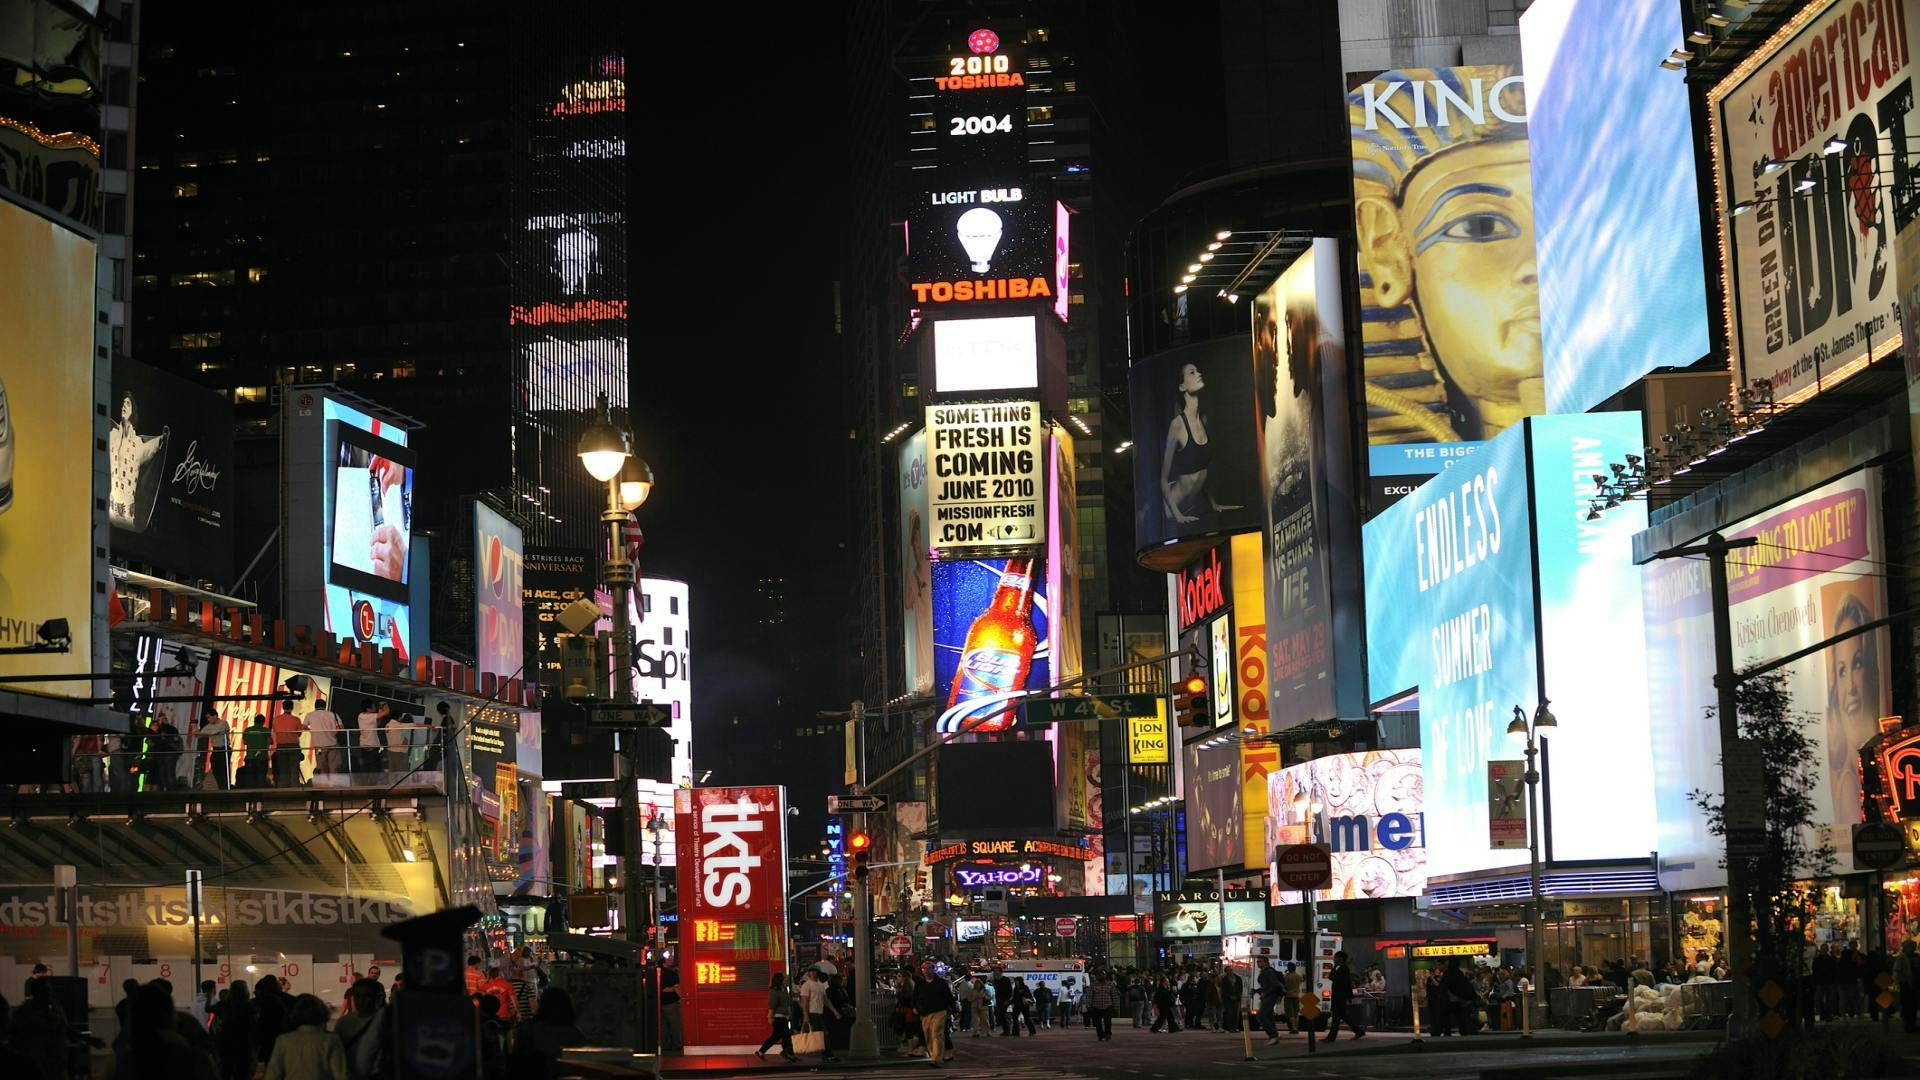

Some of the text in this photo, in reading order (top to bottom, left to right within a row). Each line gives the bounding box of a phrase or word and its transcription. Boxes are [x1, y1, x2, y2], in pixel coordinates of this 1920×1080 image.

[951, 55, 1008, 75] 2010
[936, 73, 1024, 90] TOSHIBA
[951, 115, 1012, 135] 2004
[932, 188, 1023, 205] LIGHT BULB
[912, 278, 1051, 303] TOSHIBA
[1760, 249, 1784, 355] GREEN
[1831, 331, 1855, 356] James
[934, 406, 1031, 425] SOMETHING
[935, 426, 1031, 449] FRESH IS
[1404, 448, 1435, 459] THE
[936, 450, 1033, 477] COMING
[938, 478, 1034, 500] JUNE 2010
[938, 504, 1035, 520] MISSIONFRESH
[939, 523, 983, 542] .COM
[1415, 465, 1501, 592] ENDLESS
[1783, 518, 1798, 558] TO
[1802, 507, 1833, 551] LOVE
[532, 554, 561, 562] STRIKES
[1178, 547, 1224, 631] Kodak
[1432, 603, 1492, 689] SUMMER
[1051, 702, 1065, 716] W
[1111, 698, 1132, 713] St
[1239, 624, 1277, 784] Kodak
[599, 711, 659, 721] ONE WAY
[1133, 722, 1163, 738] LION
[1134, 739, 1164, 755] KING
[838, 800, 880, 808] ONE WAY
[702, 795, 763, 907] tkts
[972, 841, 1018, 853] SQUARE.
[1286, 853, 1321, 862] DO NOT
[957, 868, 1042, 886] YAHOO!
[1161, 891, 1266, 902] MARQUIS
[1417, 946, 1484, 956] NEWSSTAND
[101, 964, 112, 977] 7
[160, 964, 171, 977] 8
[220, 964, 231, 977] 9
[281, 964, 299, 977] 10
[342, 963, 354, 977] 11
